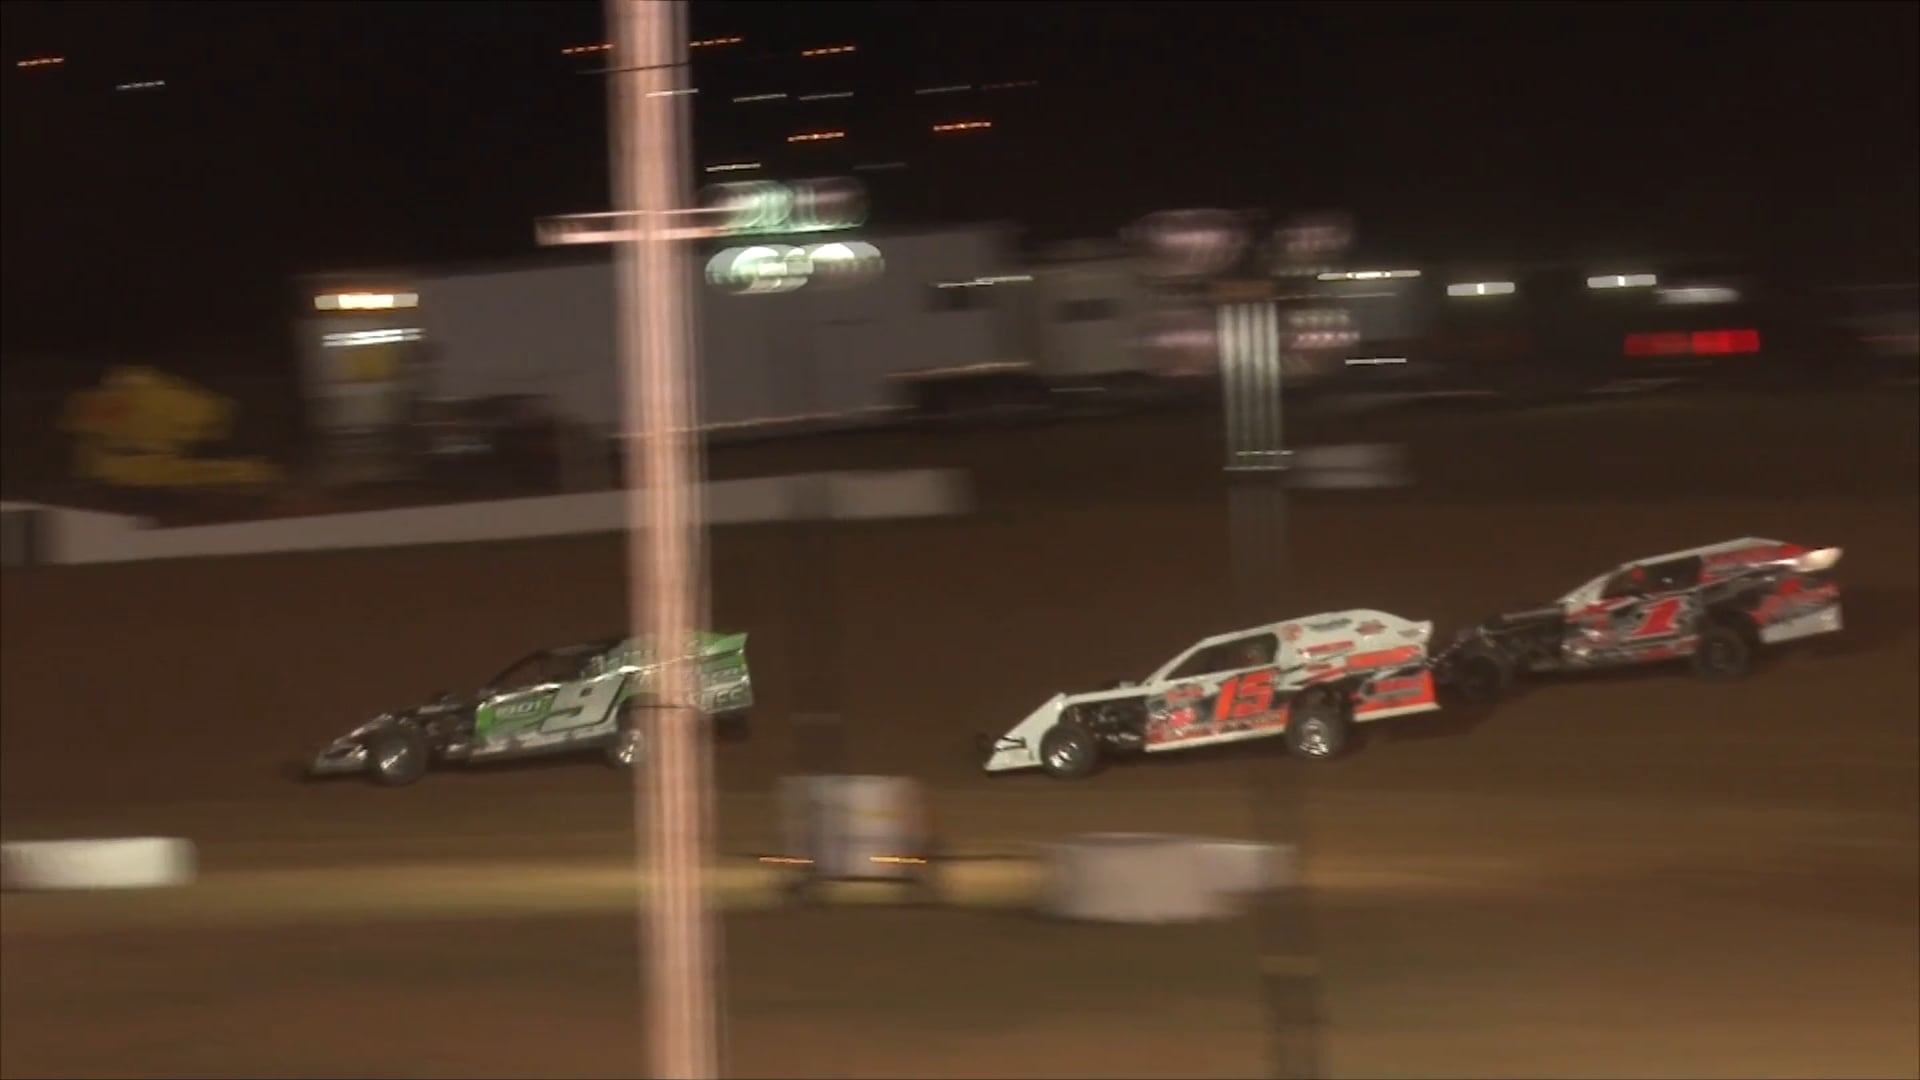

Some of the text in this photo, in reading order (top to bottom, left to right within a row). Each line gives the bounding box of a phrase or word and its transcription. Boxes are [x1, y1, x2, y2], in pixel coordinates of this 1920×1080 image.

[1629, 597, 1681, 637] 1
[541, 675, 627, 733] 9
[1215, 669, 1276, 721] 15
